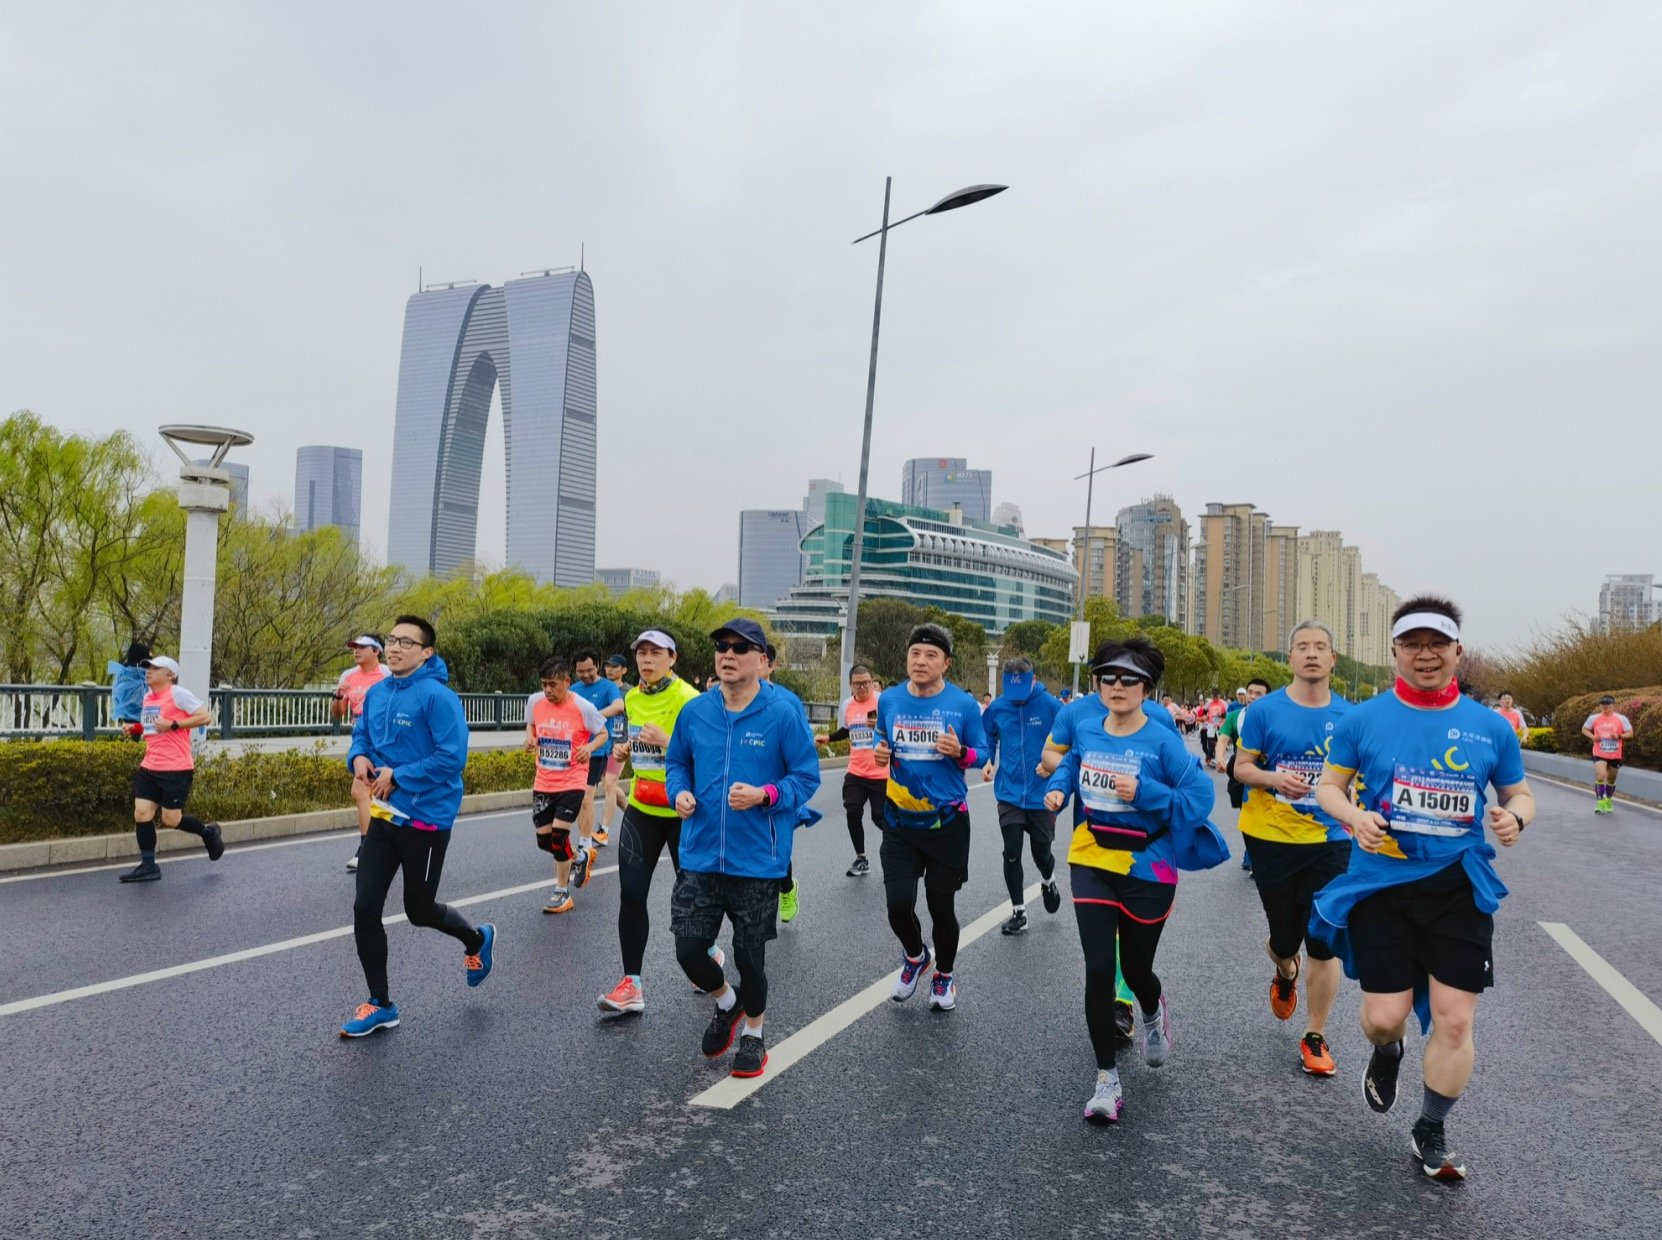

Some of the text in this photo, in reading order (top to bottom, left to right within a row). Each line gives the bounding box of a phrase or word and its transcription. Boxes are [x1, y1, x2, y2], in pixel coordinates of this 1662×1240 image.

[748, 738, 766, 747] CPIC
[895, 729, 939, 743] A 15016
[1397, 787, 1470, 813] A 15019
